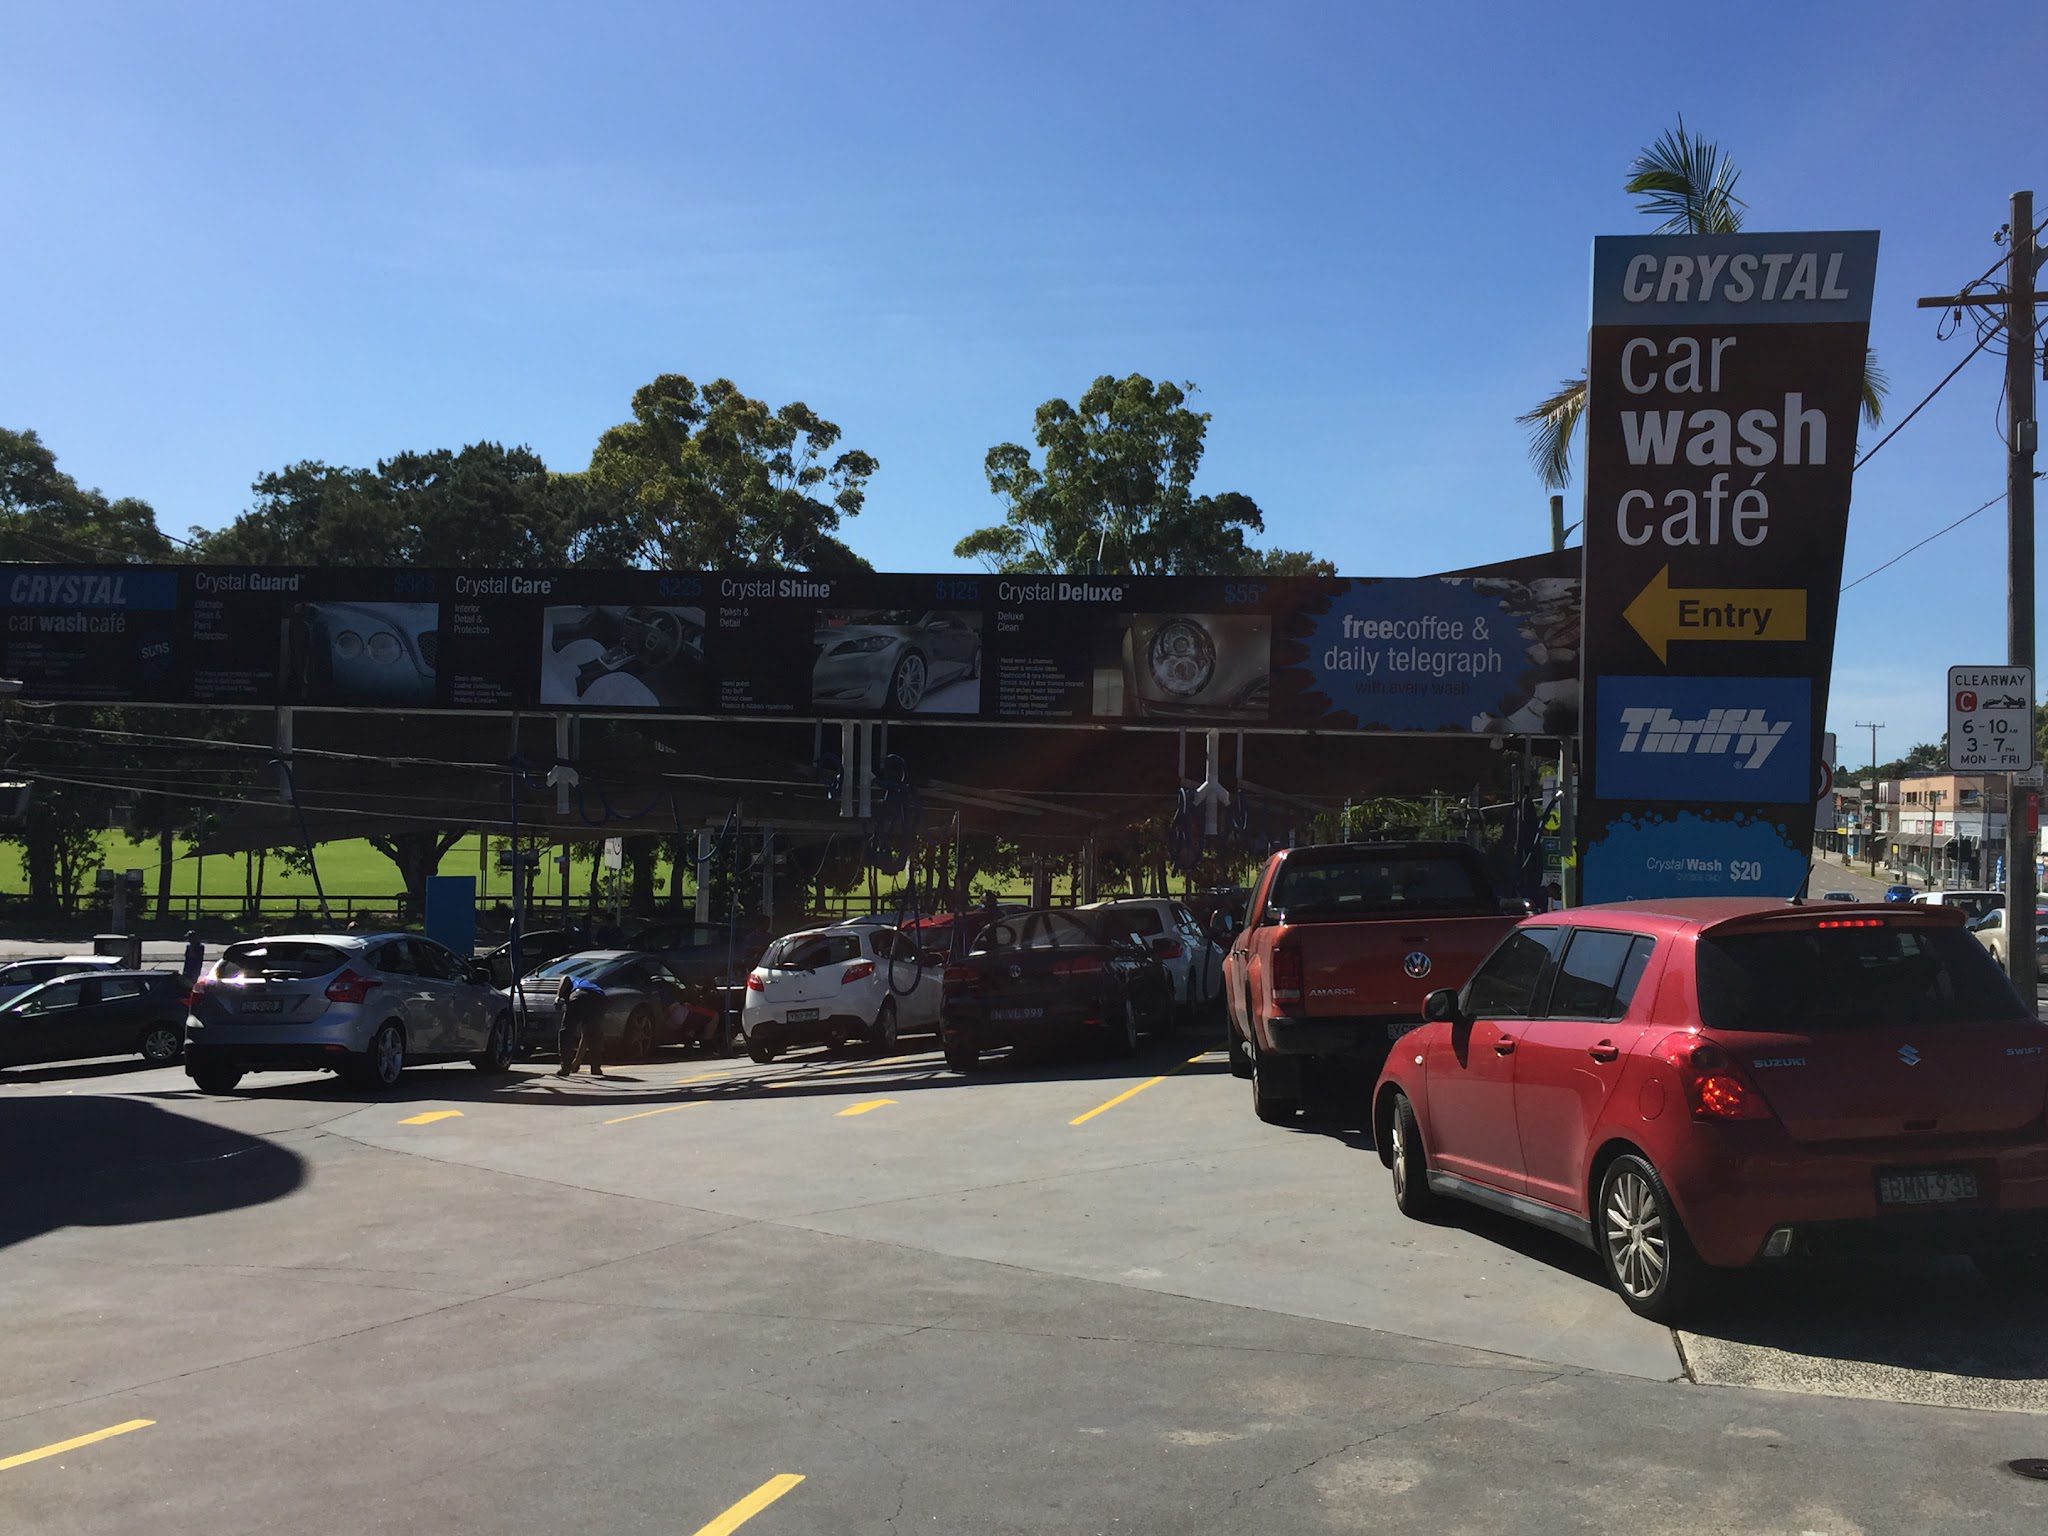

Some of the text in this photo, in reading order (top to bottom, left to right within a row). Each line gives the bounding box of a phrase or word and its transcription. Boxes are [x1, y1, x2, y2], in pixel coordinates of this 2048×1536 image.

[1622, 252, 1850, 303] CRYSTAL
[1620, 336, 1737, 395] car
[1620, 392, 1828, 467] wash
[1616, 471, 1770, 547] café
[9, 573, 128, 605] CRYSTAL
[195, 572, 300, 594] Crystal Guard
[455, 574, 552, 597] Crystal Care
[721, 578, 831, 601] Crystal Shine
[998, 581, 1124, 605] Crystal Deluxe
[8, 614, 36, 633] car
[39, 611, 87, 633] wash
[997, 611, 1025, 621] Deluxe
[997, 622, 1020, 632] Clean
[1678, 600, 1773, 635] Entry
[1472, 615, 1490, 641] &
[1323, 645, 1502, 678] daily telegraph
[1355, 680, 1386, 695] with
[1432, 680, 1471, 696] wash
[1955, 674, 2027, 686] CLEARWAY
[1960, 692, 1973, 711] C
[1618, 707, 1793, 769] Thrifty
[1960, 754, 1987, 764] MON
[2001, 754, 2020, 764] FRI
[1646, 857, 1685, 873] Crystal
[1686, 858, 1722, 872] Wash
[1730, 860, 1761, 881] $20
[1308, 987, 1357, 997] AMAROK
[1753, 1057, 1807, 1068] SUZUKI
[2006, 1046, 2044, 1056] SWIFT
